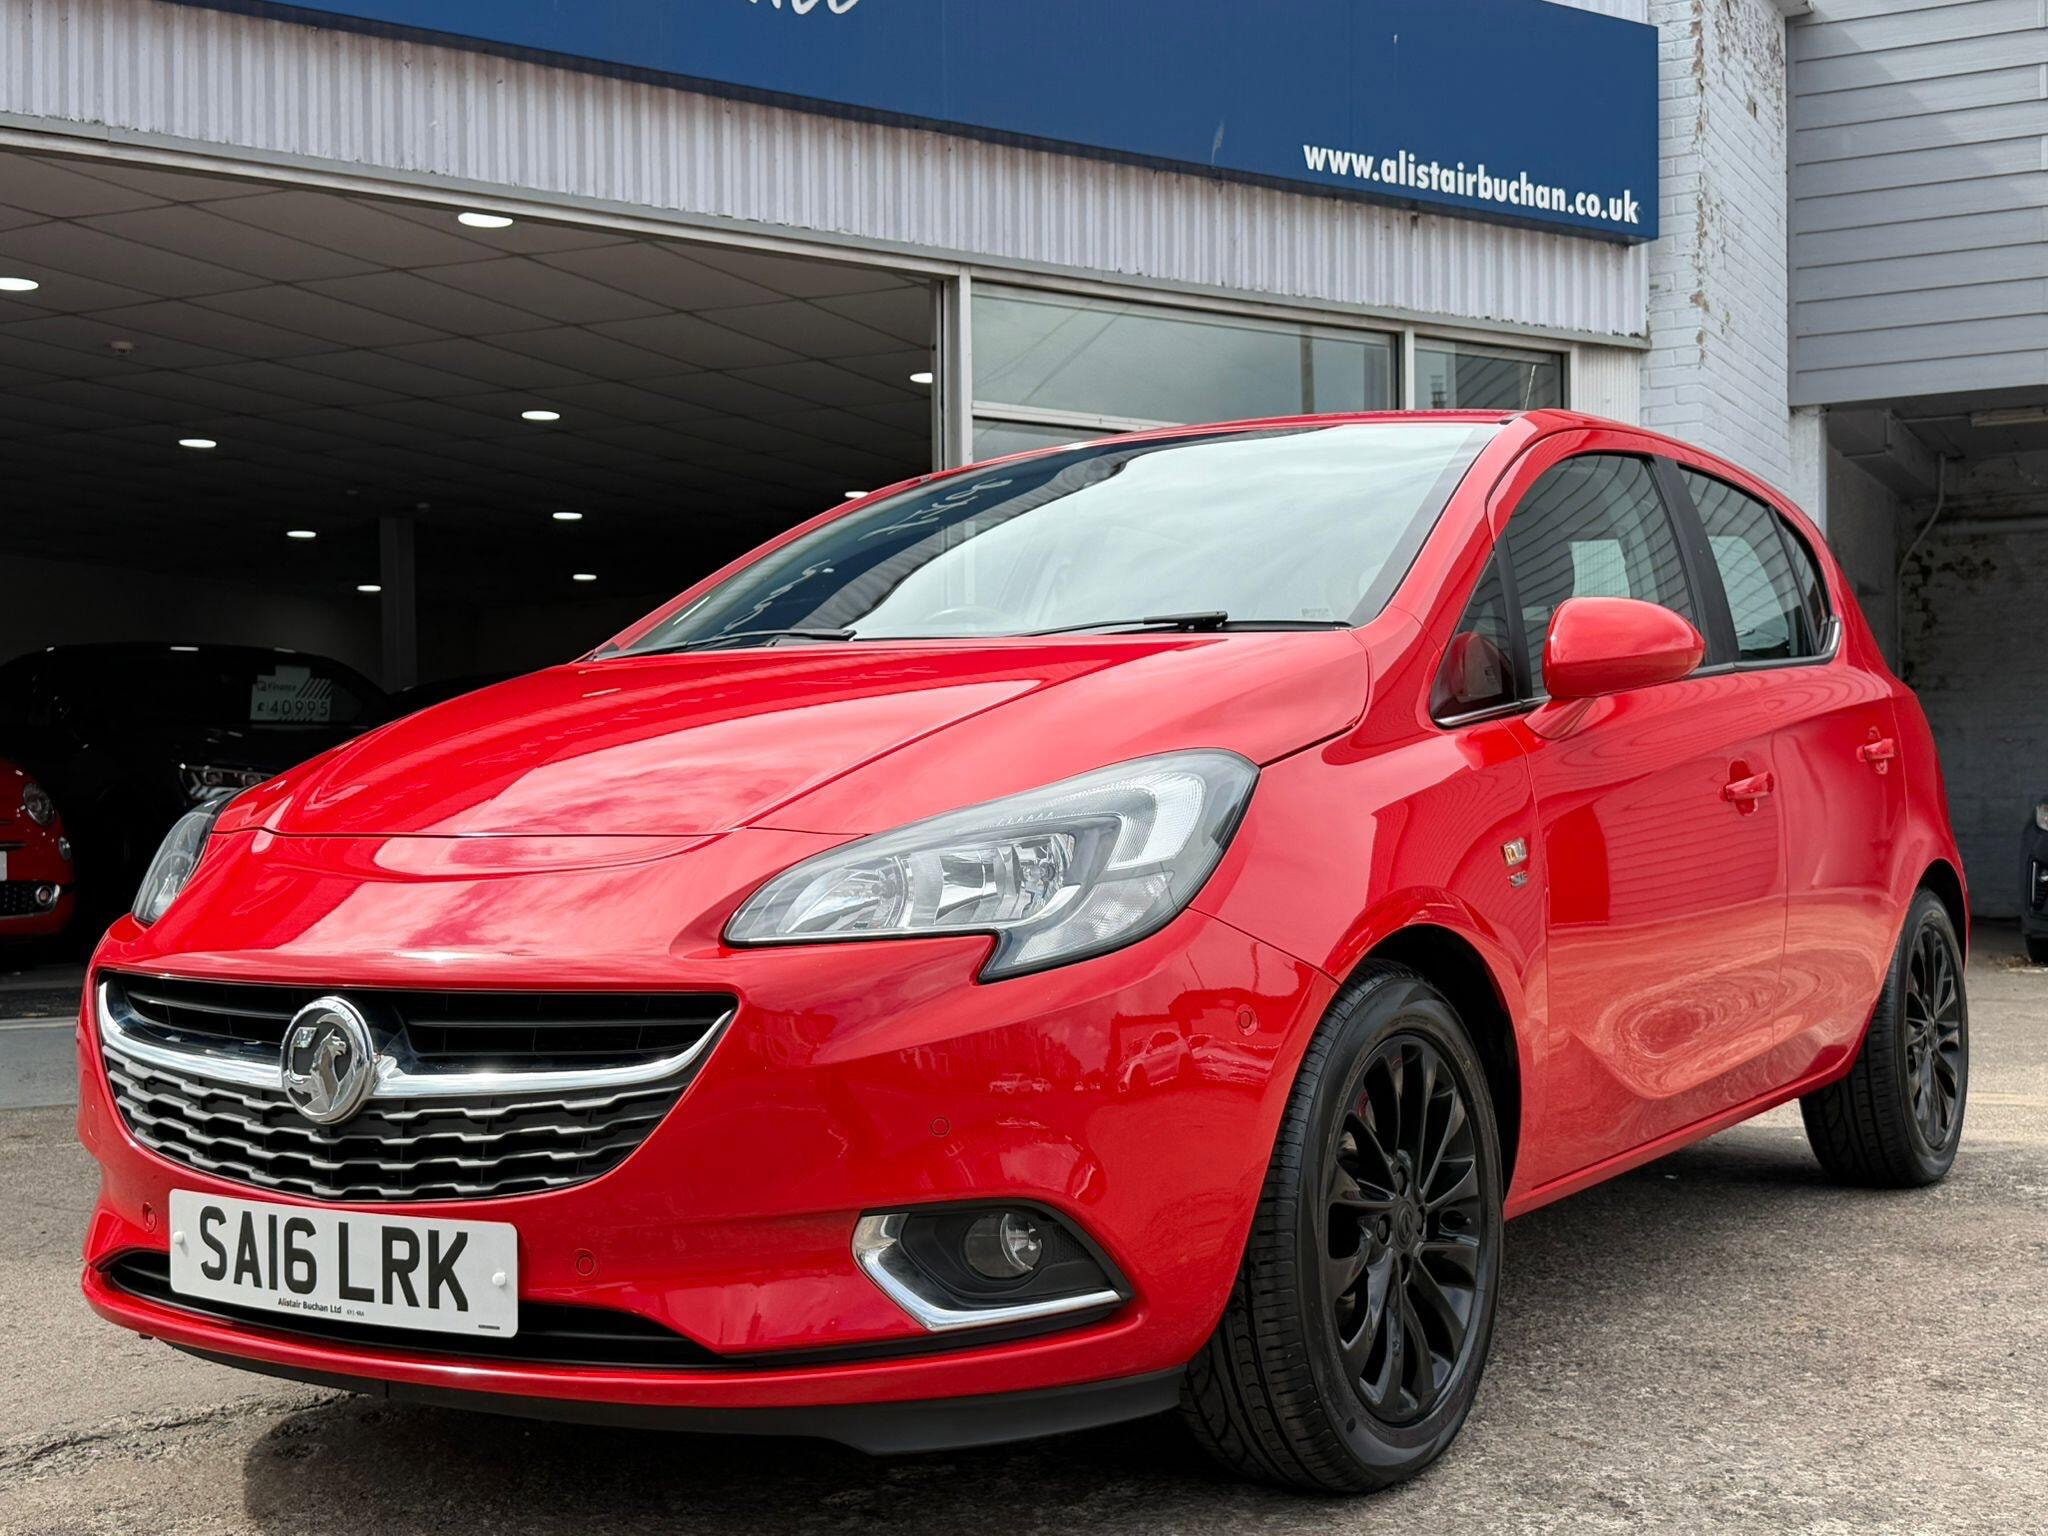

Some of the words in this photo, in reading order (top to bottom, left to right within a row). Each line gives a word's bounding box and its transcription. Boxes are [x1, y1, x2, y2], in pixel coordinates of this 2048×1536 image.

[1303, 145, 1639, 224] www.alistairbuchan.co.uk
[200, 1205, 317, 1295] SA16
[338, 1222, 469, 1312] LRK
[278, 1298, 301, 1309] Alistair
[303, 1301, 328, 1312] Buchan
[330, 1305, 342, 1314] Ltd
